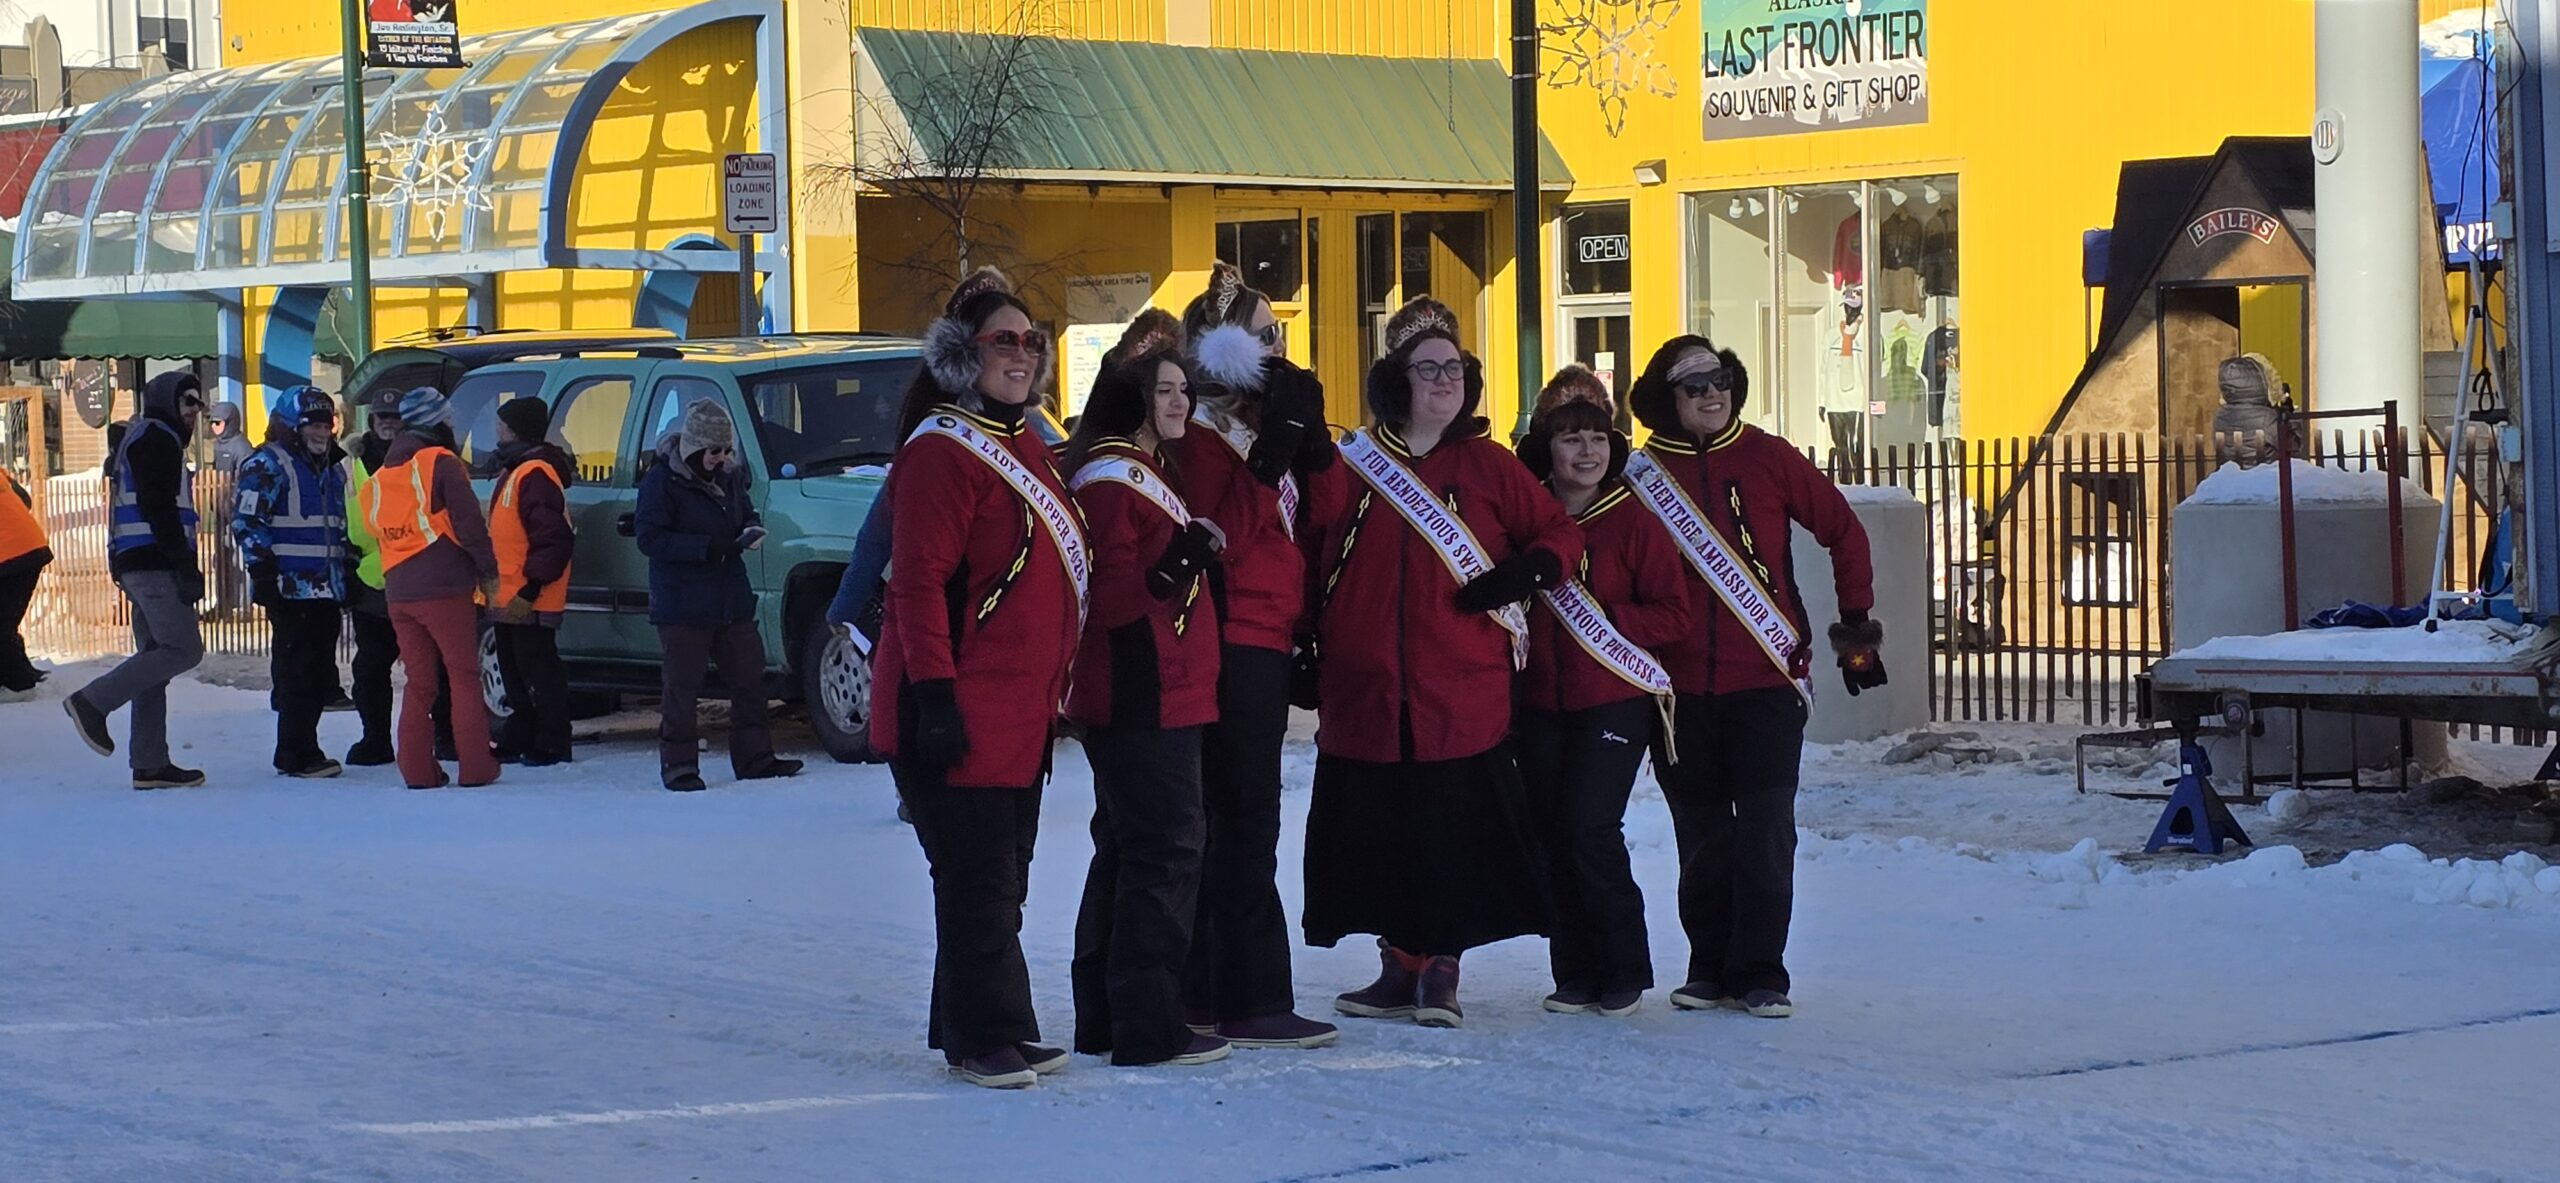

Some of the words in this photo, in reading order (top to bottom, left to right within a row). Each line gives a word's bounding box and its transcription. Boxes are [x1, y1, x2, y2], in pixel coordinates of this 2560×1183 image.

[1704, 25, 1775, 78] LAST
[1783, 9, 1924, 71] FRONTIER
[1708, 85, 1797, 119] SOUVENIR
[1803, 83, 1817, 110] &
[1823, 79, 1863, 108] GIFT
[1868, 74, 1920, 104] SHOP
[726, 158, 741, 175] NO
[729, 182, 772, 194] LOADING
[738, 198, 764, 209] ZONE
[2193, 211, 2275, 240] BAILEYS
[1583, 238, 1626, 259] OPEN
[980, 440, 1020, 474] LADY
[1022, 474, 1070, 542] TRAPPER
[1066, 540, 1085, 582] 2026
[1361, 449, 1390, 478] FUR
[1383, 470, 1460, 546] RENDEZVOUS
[1647, 478, 1704, 544] HERITAGE
[1696, 539, 1768, 626] AMBASSADOR
[1764, 622, 1794, 659] 2026
[1552, 584, 1609, 645] DEZVOUS
[1601, 636, 1656, 684] PRINCESS
